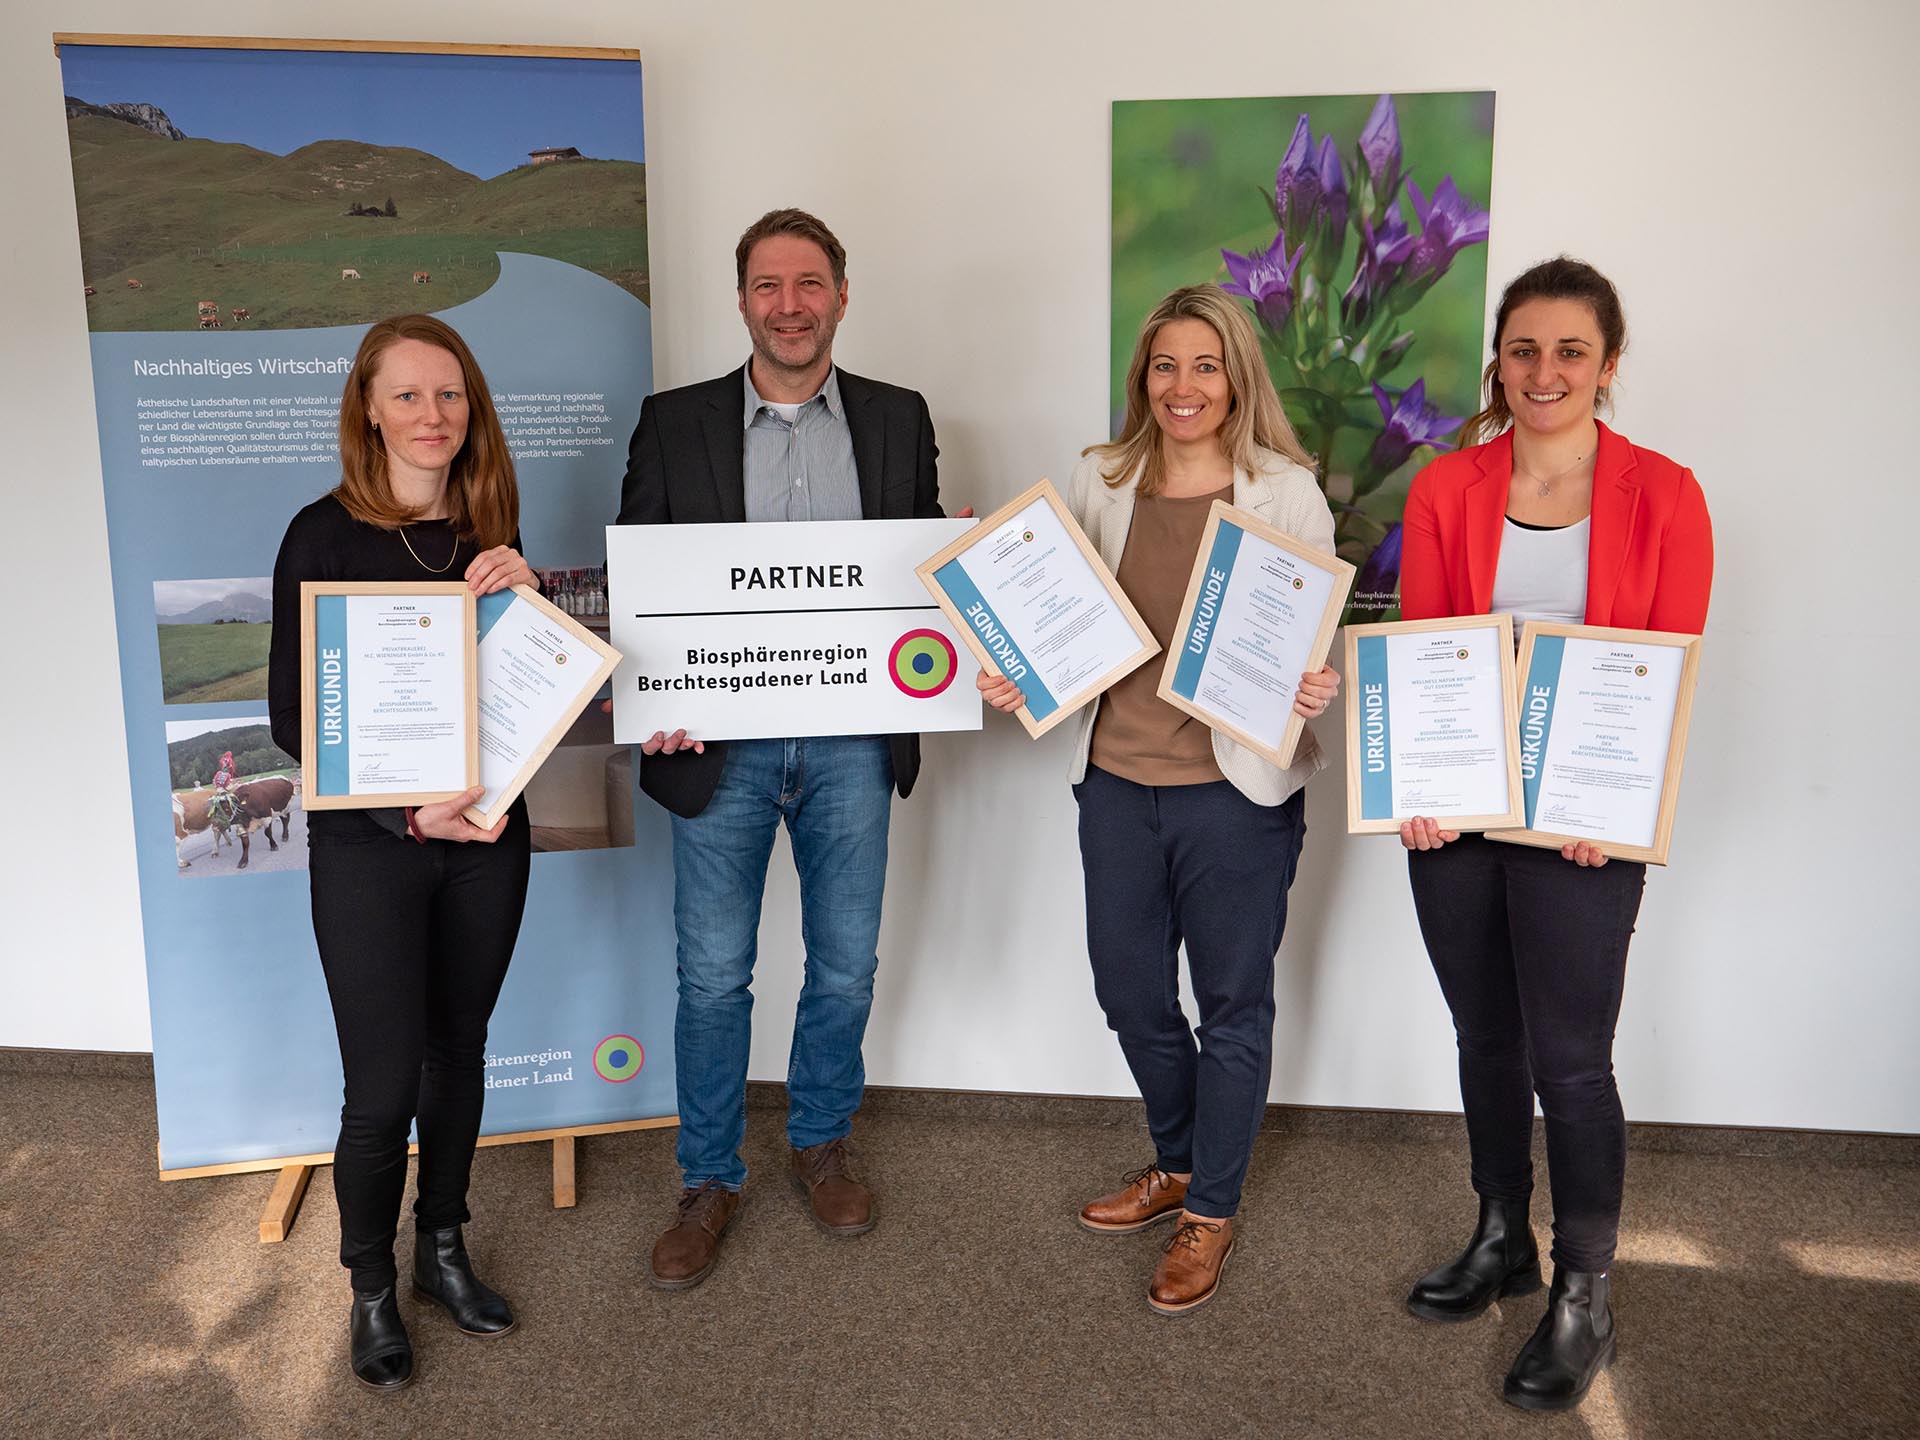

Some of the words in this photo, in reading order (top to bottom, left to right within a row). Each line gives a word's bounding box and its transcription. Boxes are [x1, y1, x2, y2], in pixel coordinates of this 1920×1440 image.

[134, 358, 252, 378] Nachhaltiges
[137, 397, 188, 407] Ästhetische
[191, 396, 250, 406] Landschaften
[253, 396, 267, 405] mit
[270, 396, 292, 405] einer
[294, 396, 328, 405] Vielzahl
[508, 393, 561, 402] Vermarktung
[564, 392, 604, 402] regionaler
[138, 410, 190, 419] schiedlicher
[193, 409, 253, 418] Lebensräume
[256, 409, 273, 417] sind
[545, 404, 560, 412] und
[563, 404, 604, 413] nachhaltig
[157, 422, 178, 430] Land
[182, 422, 195, 430] die
[198, 421, 242, 431] wichtigste
[245, 420, 290, 430] Grundlage
[293, 420, 308, 428] des
[502, 416, 517, 424] und
[520, 415, 578, 424] handwerkliche
[582, 415, 612, 423] Produk-
[512, 426, 557, 435] Landschaft
[559, 426, 574, 434] bei.
[577, 426, 601, 434] Durch
[140, 434, 150, 442] In
[153, 434, 167, 442] der
[170, 433, 247, 444] Biosphärenregion
[250, 432, 275, 440] sollen
[279, 432, 302, 440] durch
[546, 437, 614, 446] Partnerbetrieben
[141, 446, 164, 454] eines
[168, 445, 224, 455] nachhaltigen
[226, 444, 308, 454] Qualitätstourismus
[516, 450, 549, 459] gestärkt
[552, 449, 584, 457] werden.
[142, 458, 198, 467] naltypischen
[200, 456, 260, 465] Lebensräume
[263, 455, 298, 463] erhalten
[301, 454, 336, 463] werden.
[730, 564, 864, 590] PARTNER
[1189, 566, 1225, 654] URKUNDE
[966, 601, 1028, 680] URKUNDE
[687, 644, 868, 668] Biosphärenregion
[638, 673, 813, 692] Berchtesgadener
[820, 668, 868, 685] Land
[324, 648, 342, 745] URKUNDE
[1366, 682, 1385, 772] URKUNDE
[1522, 686, 1550, 779] URKUNDE
[533, 1067, 573, 1085] Land
